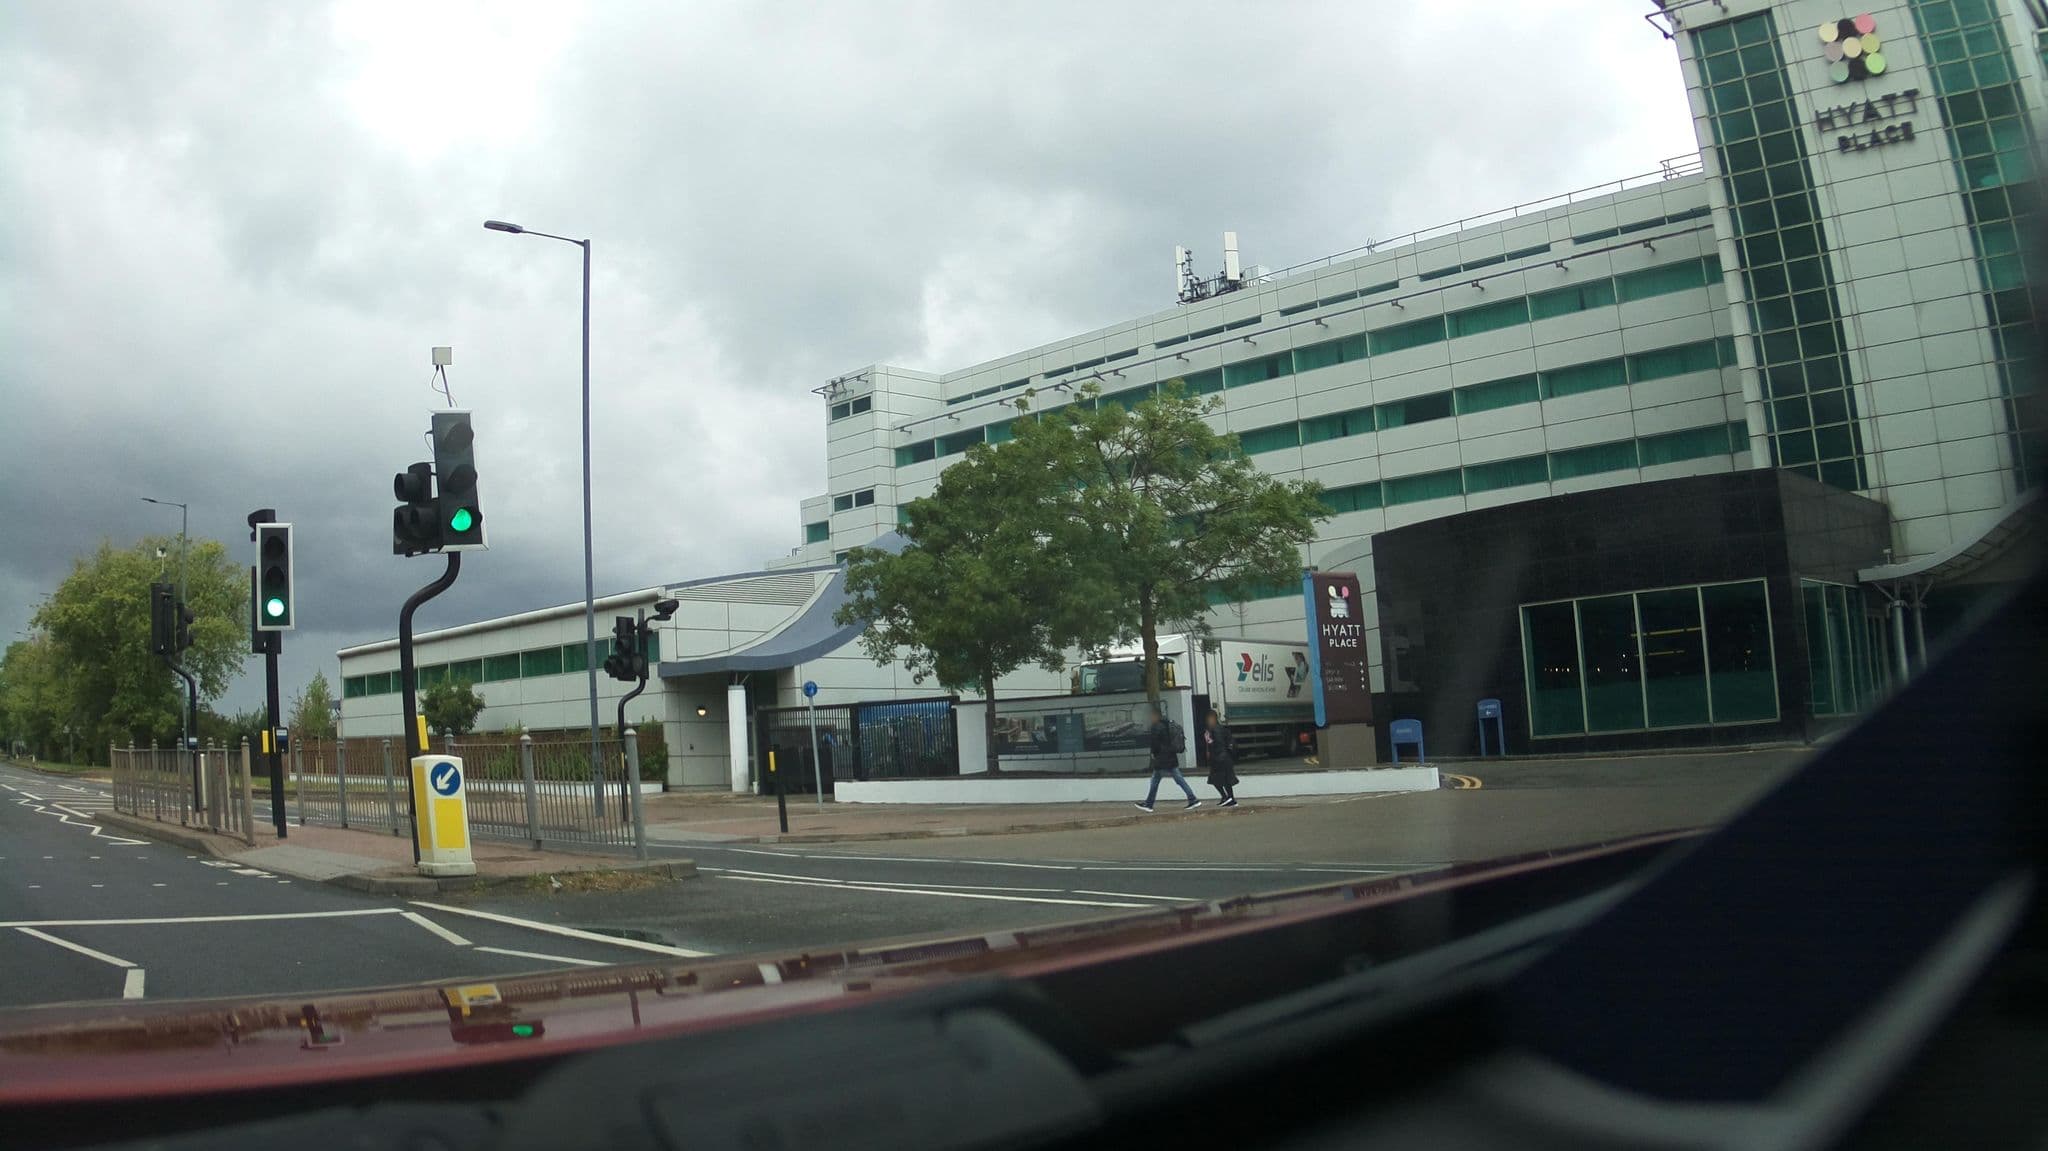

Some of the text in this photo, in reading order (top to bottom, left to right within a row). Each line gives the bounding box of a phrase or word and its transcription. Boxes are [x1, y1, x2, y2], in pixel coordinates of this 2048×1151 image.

[1815, 88, 1920, 132] HYATT
[1838, 121, 1915, 153] PLACE
[1322, 624, 1361, 637] HYATT
[1329, 638, 1357, 648] PLACE
[1252, 653, 1274, 682] elis
